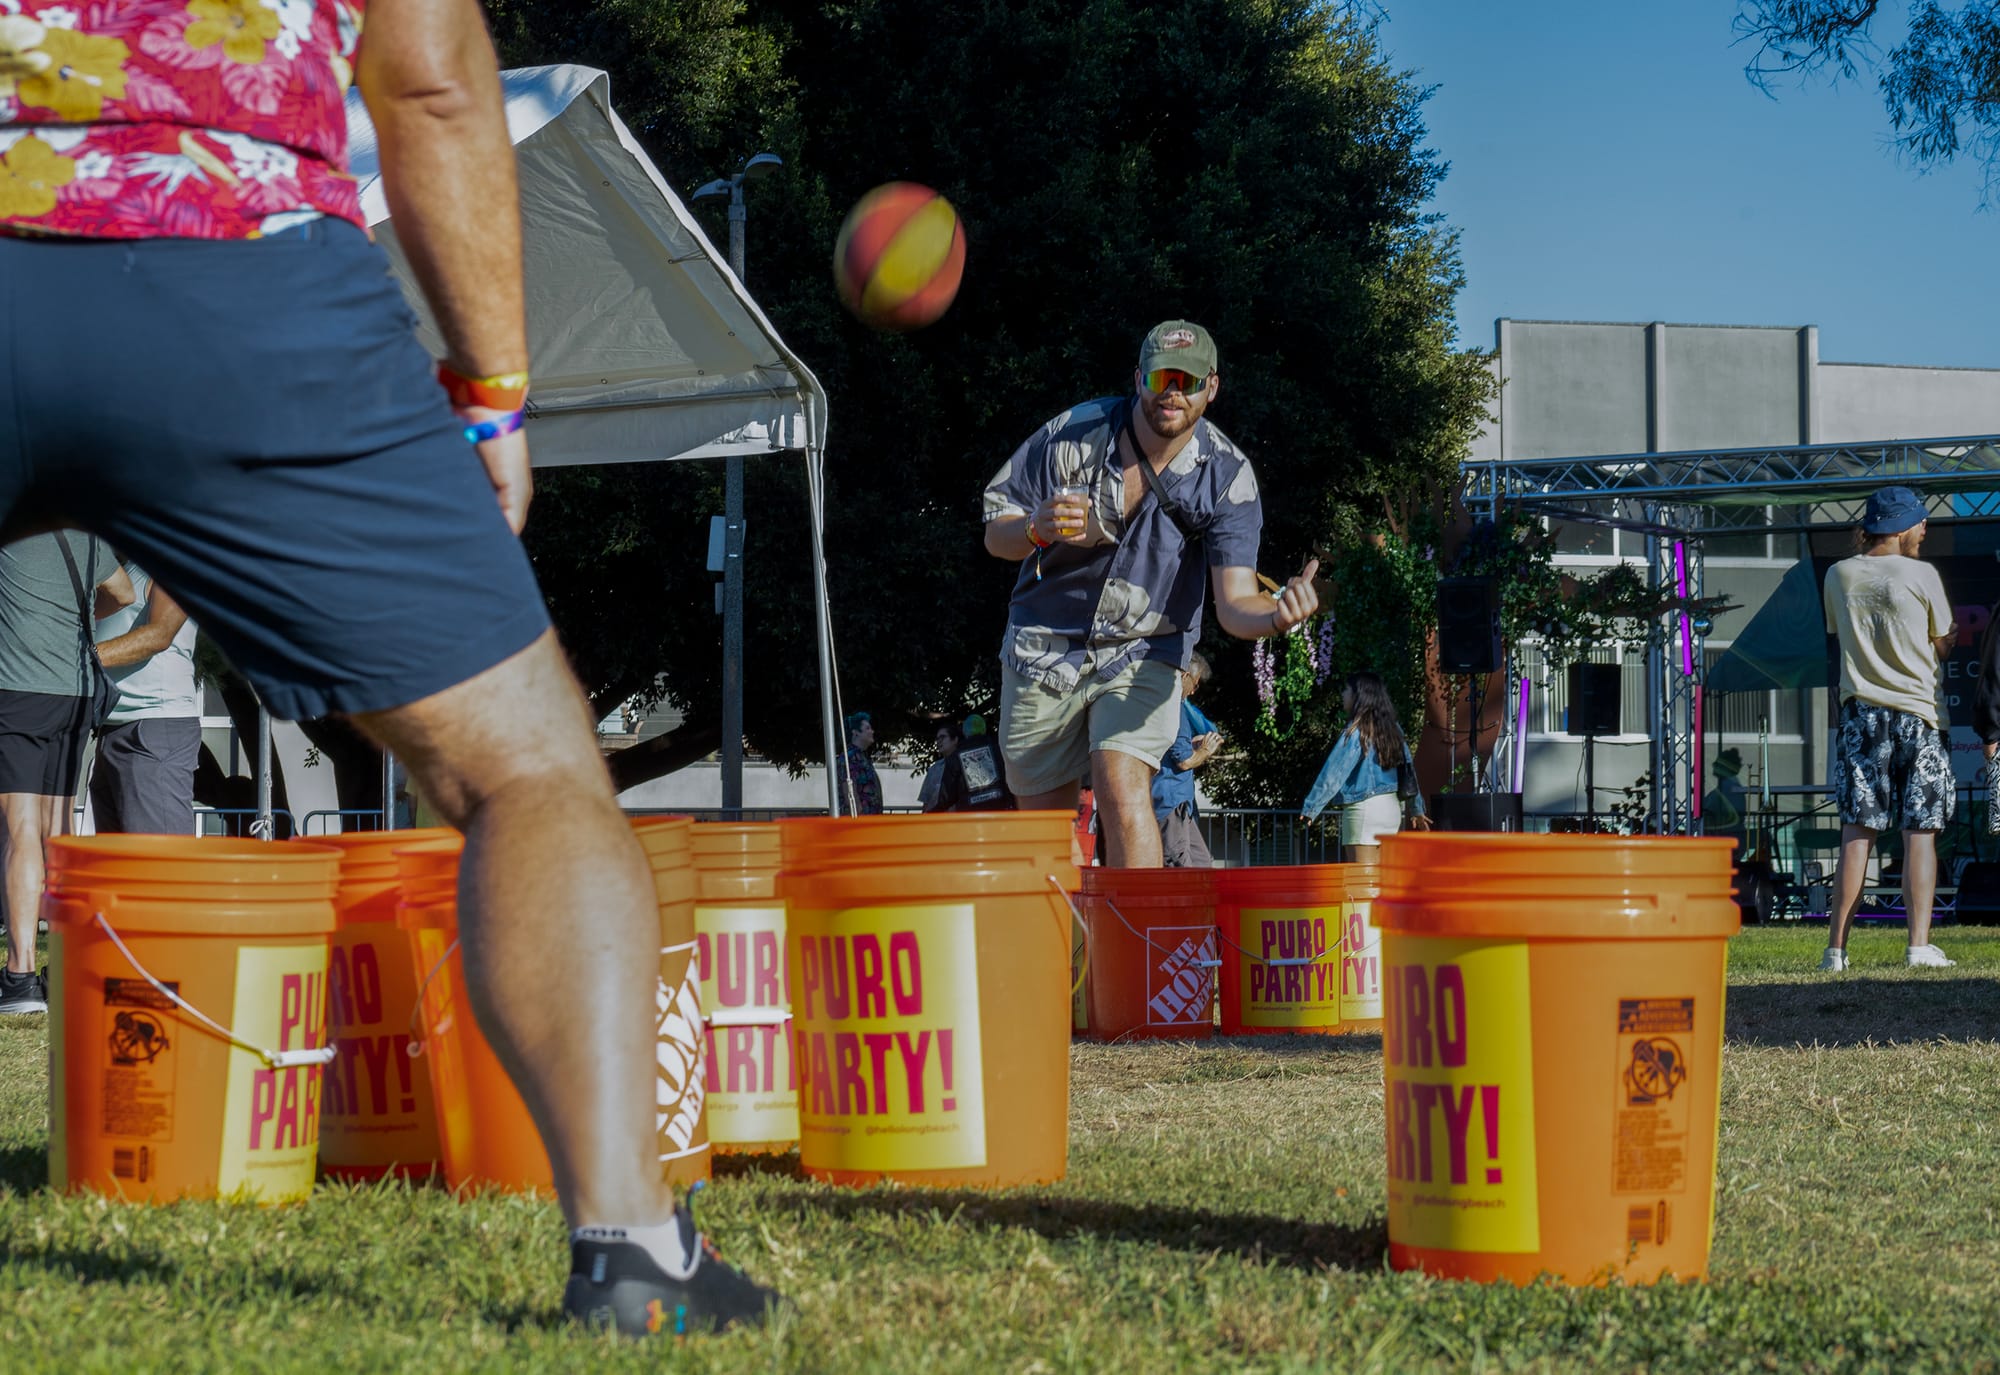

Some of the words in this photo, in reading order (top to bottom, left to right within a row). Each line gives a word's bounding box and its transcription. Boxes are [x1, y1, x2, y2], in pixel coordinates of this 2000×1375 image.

[1158, 936, 1198, 977] THE
[1261, 917, 1326, 960] PURO
[801, 930, 923, 1021] PURO
[1251, 962, 1334, 1004] PARTY!
[797, 1028, 958, 1117] PARTY!
[1387, 1079, 1503, 1186] RTY!
